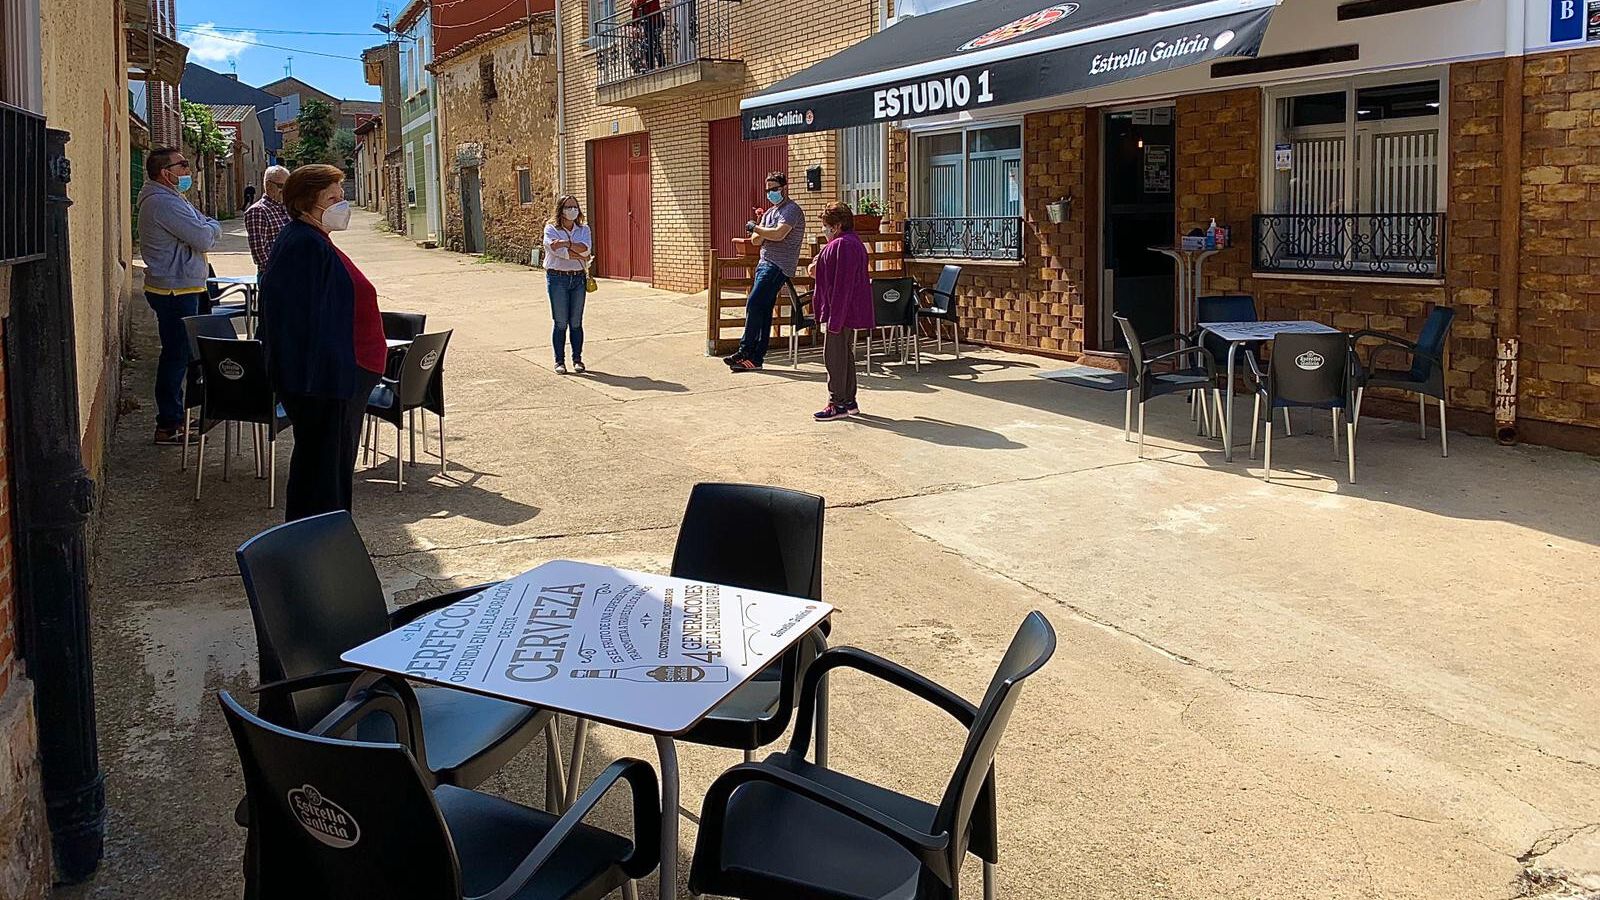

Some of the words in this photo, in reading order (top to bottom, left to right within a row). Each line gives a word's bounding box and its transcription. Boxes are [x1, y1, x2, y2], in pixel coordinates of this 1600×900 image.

[1560, 0, 1574, 19] B
[1088, 48, 1147, 75] Estrella
[1150, 33, 1209, 62] Galicia
[874, 75, 971, 119] ESTUDIO
[978, 70, 993, 103] 1
[750, 114, 776, 131] Estrella
[776, 109, 803, 127] Galicia
[601, 612, 613, 623] UNA
[681, 584, 703, 649] GENERACIONES
[498, 631, 512, 639] DE
[504, 583, 586, 683] CERVEZA
[600, 622, 611, 631] DE
[705, 630, 720, 638] LA
[600, 631, 615, 649] FRUTO
[705, 640, 720, 649] DE
[449, 644, 483, 683] OBTENIDA
[469, 633, 489, 645] EN
[606, 648, 619, 657] EL
[609, 654, 624, 664] ES
[680, 651, 720, 663] 4
[294, 795, 347, 825] Estrella
[300, 811, 349, 839] Galicia
